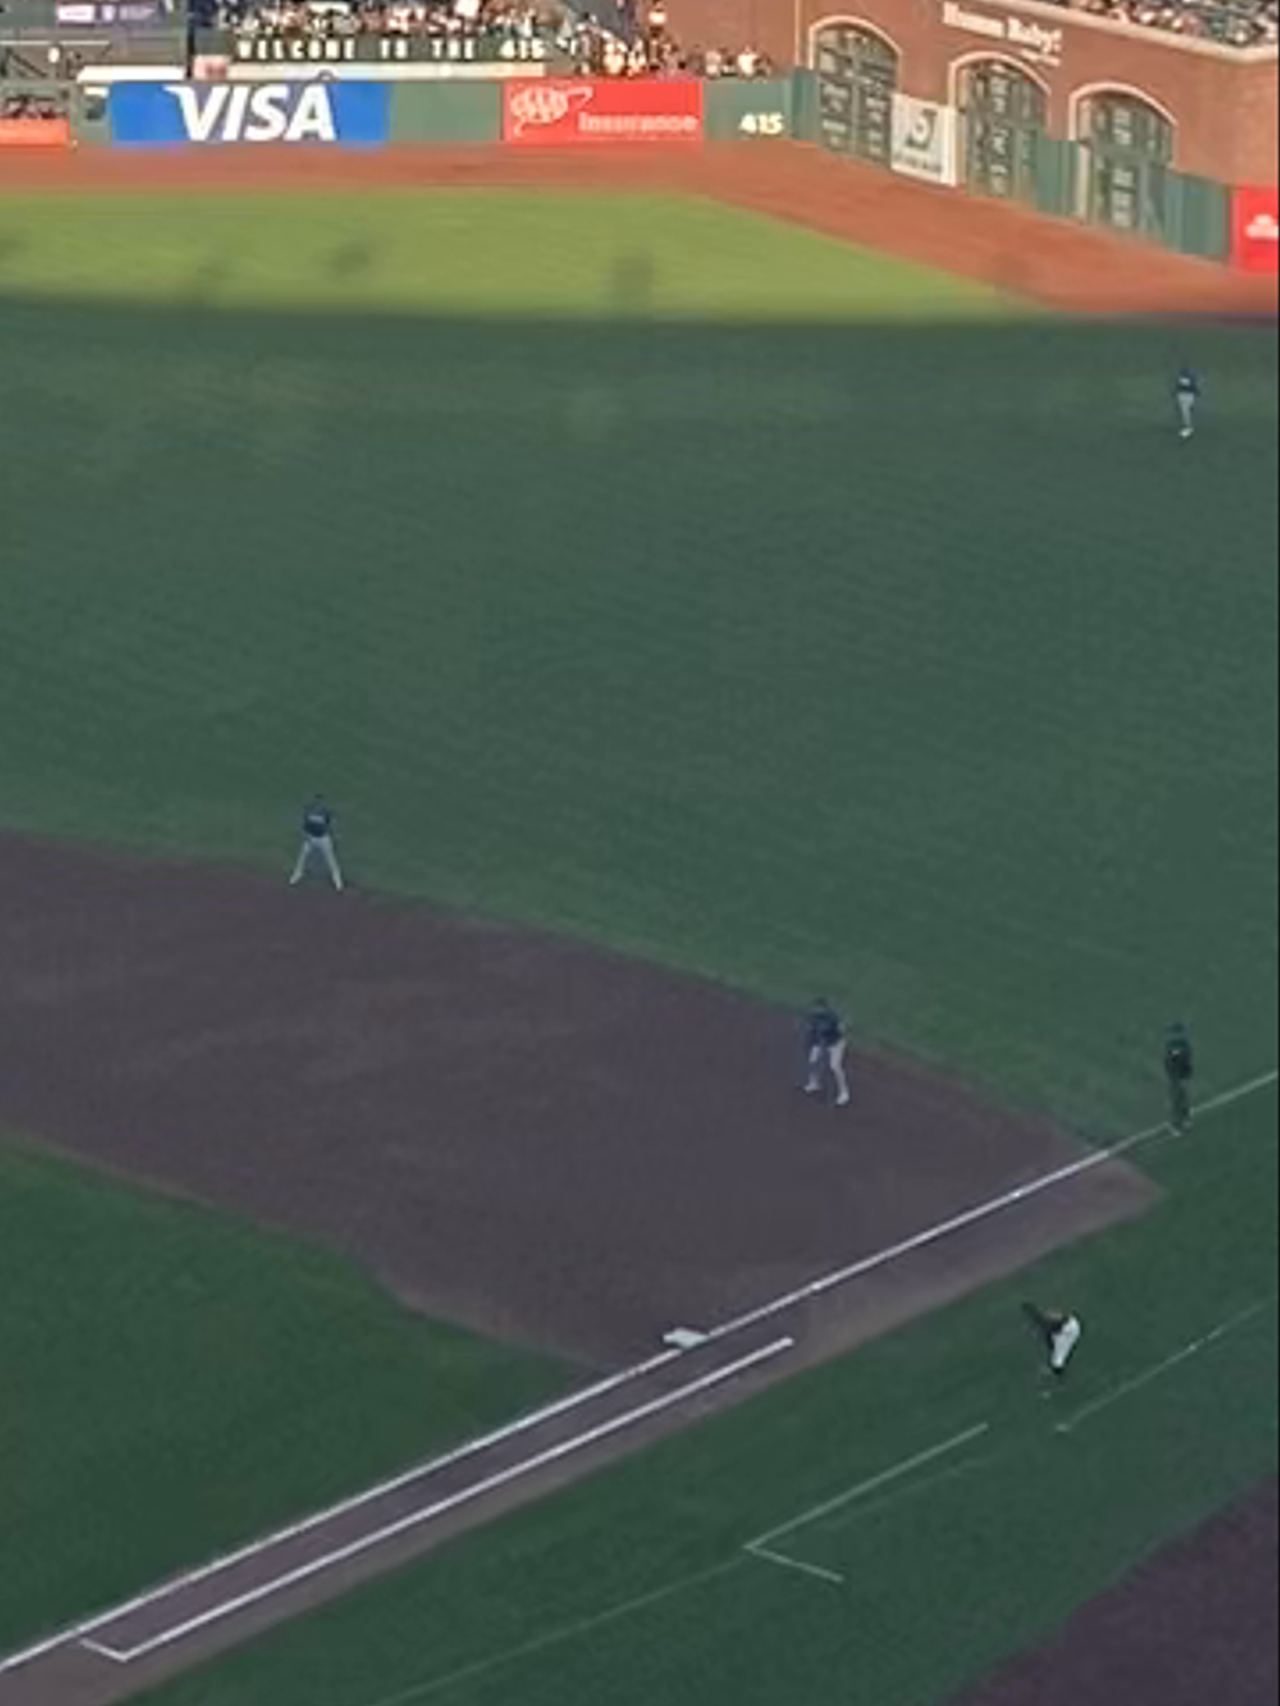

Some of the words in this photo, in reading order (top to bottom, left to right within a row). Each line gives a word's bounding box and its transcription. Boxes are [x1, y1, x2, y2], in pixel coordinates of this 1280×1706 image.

[238, 38, 355, 59] WELCOME
[380, 38, 408, 59] TO
[432, 38, 475, 59] THE
[500, 38, 544, 59] 415
[162, 84, 338, 141] VISA
[578, 112, 699, 132] Insurance
[739, 112, 783, 134] 415
